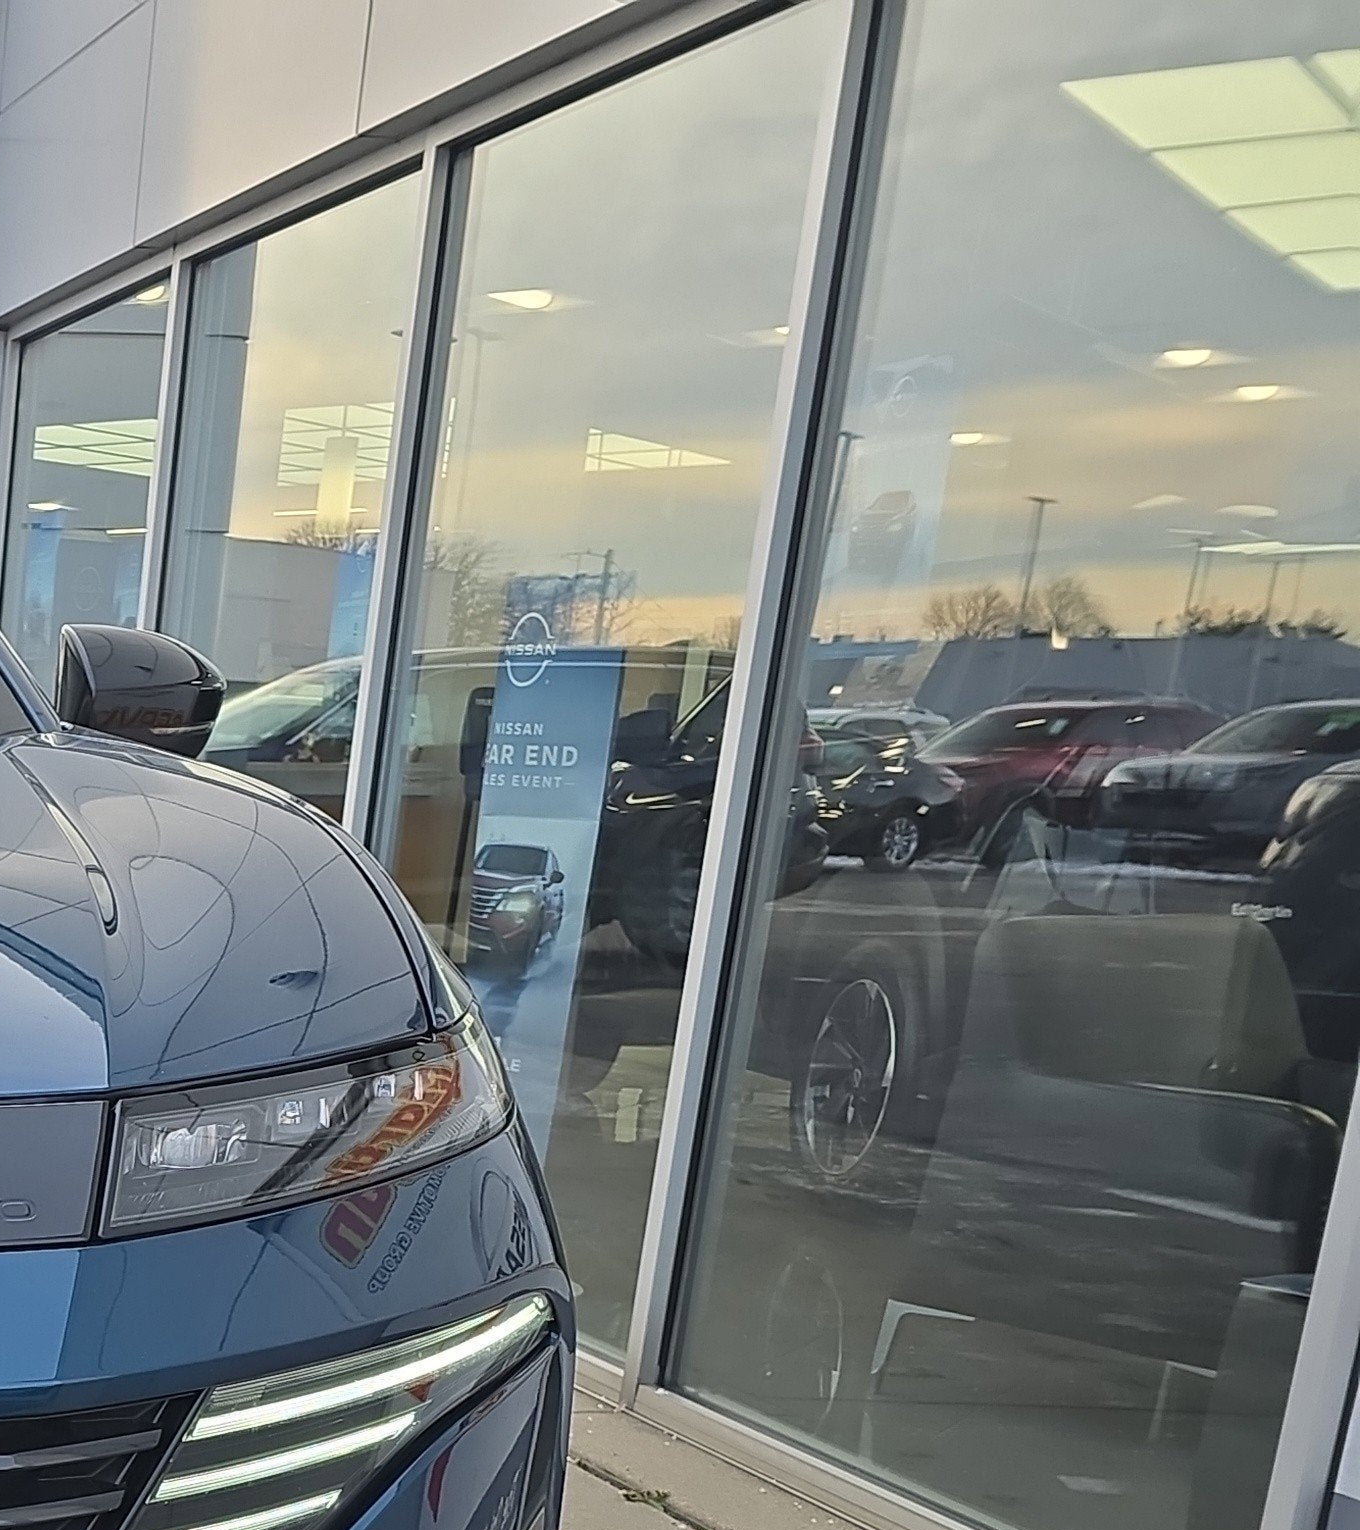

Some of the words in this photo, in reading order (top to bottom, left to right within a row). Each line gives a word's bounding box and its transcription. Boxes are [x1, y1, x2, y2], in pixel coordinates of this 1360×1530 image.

[505, 643, 556, 656] NISSAN
[493, 722, 544, 736] NISSAN
[524, 744, 579, 767] END
[511, 774, 563, 788] EVENT
